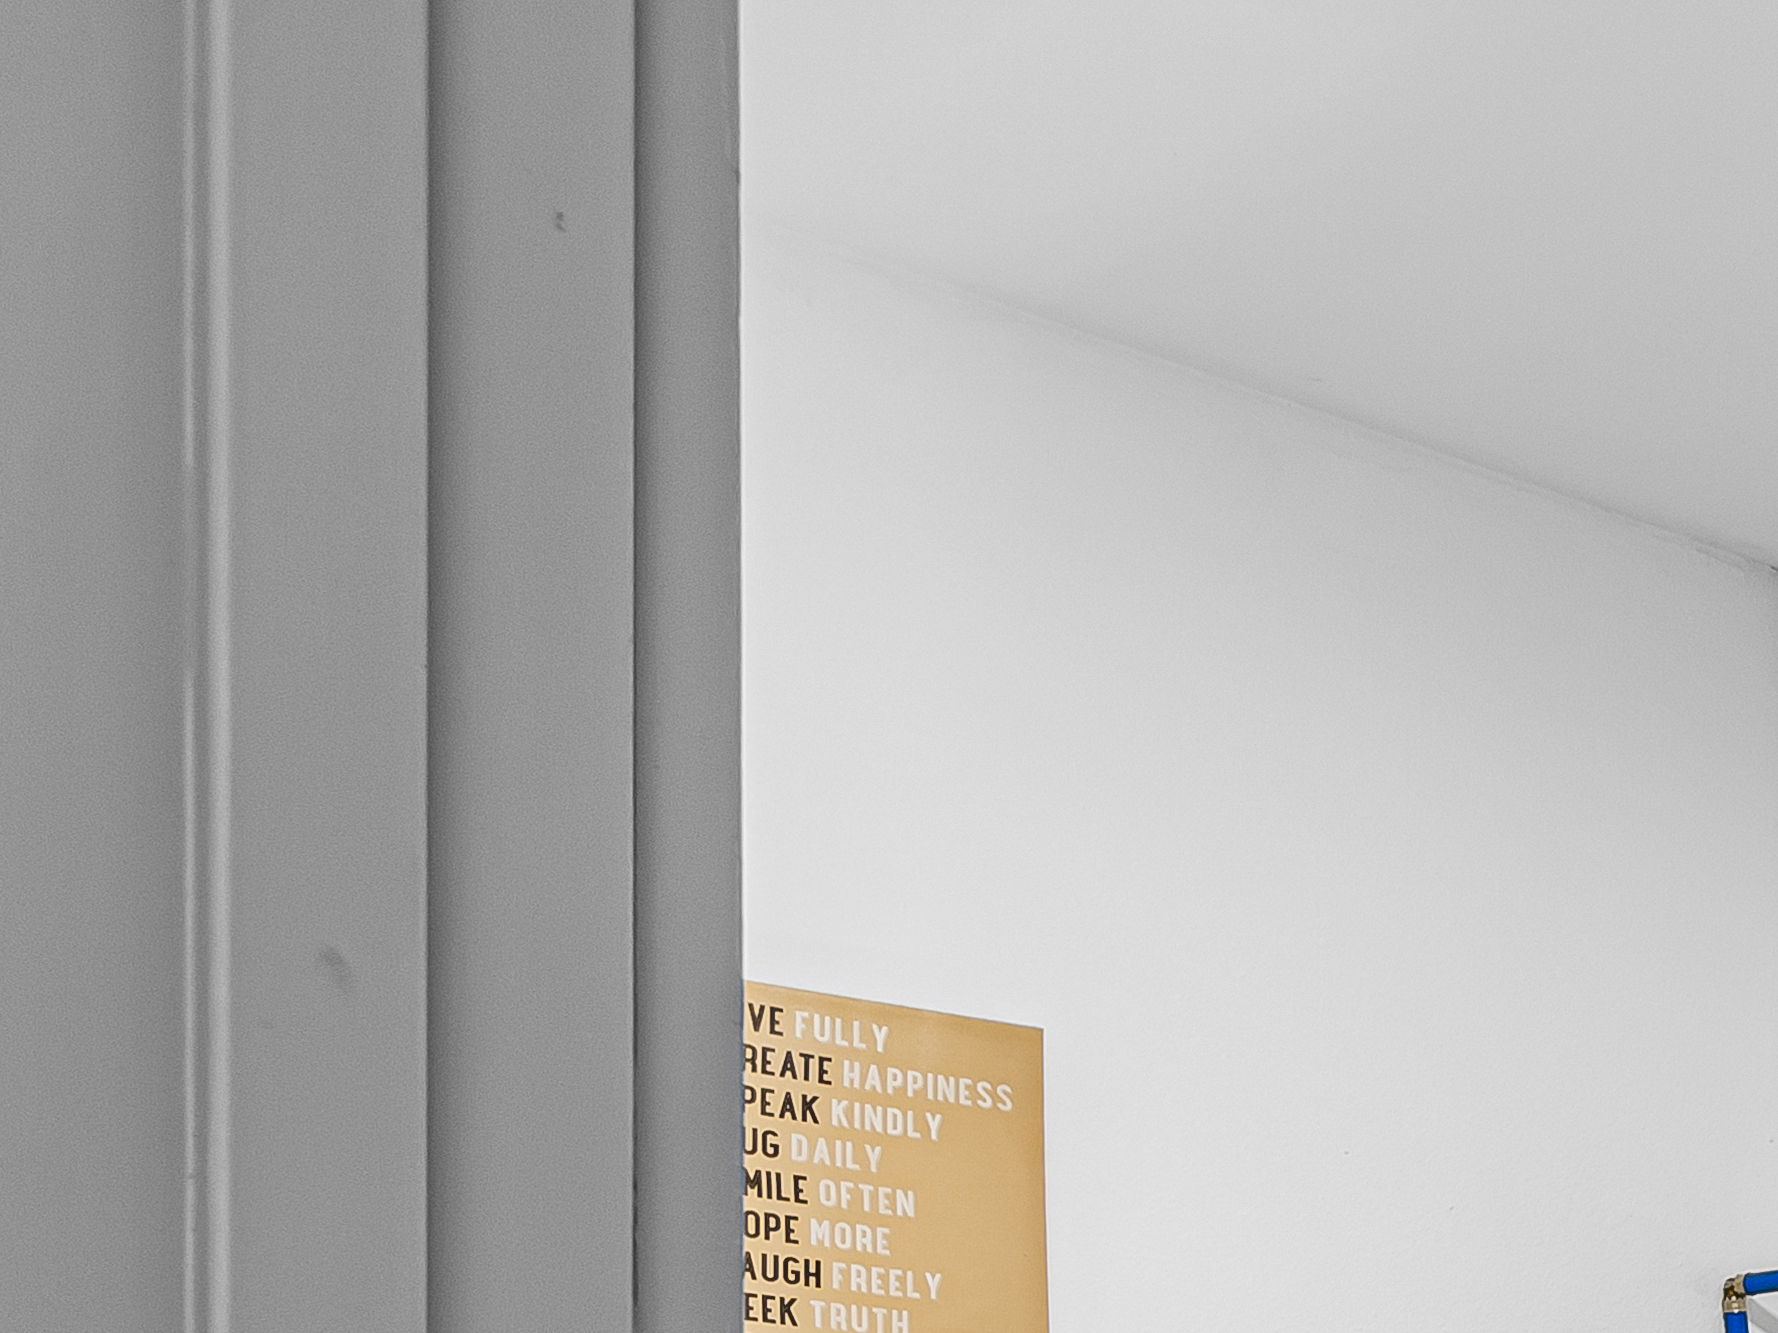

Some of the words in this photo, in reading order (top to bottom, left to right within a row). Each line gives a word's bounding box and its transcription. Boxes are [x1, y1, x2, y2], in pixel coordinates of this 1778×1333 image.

[747, 1002, 784, 1037] VE
[794, 1010, 889, 1053] FULLY
[743, 1043, 833, 1086] REATE
[843, 1060, 1014, 1112] HAPPINESS
[743, 1084, 820, 1125] PEAK
[830, 1099, 943, 1141] KINDLY
[743, 1127, 780, 1159] UG
[790, 1132, 882, 1173] DAILY
[743, 1166, 808, 1205] MILE
[818, 1178, 915, 1218] OFTEN
[744, 1210, 800, 1245] OPE
[809, 1217, 891, 1256] MORE
[743, 1251, 822, 1289] AUGH
[831, 1261, 942, 1300] FREELY
[744, 1292, 799, 1327] EEK
